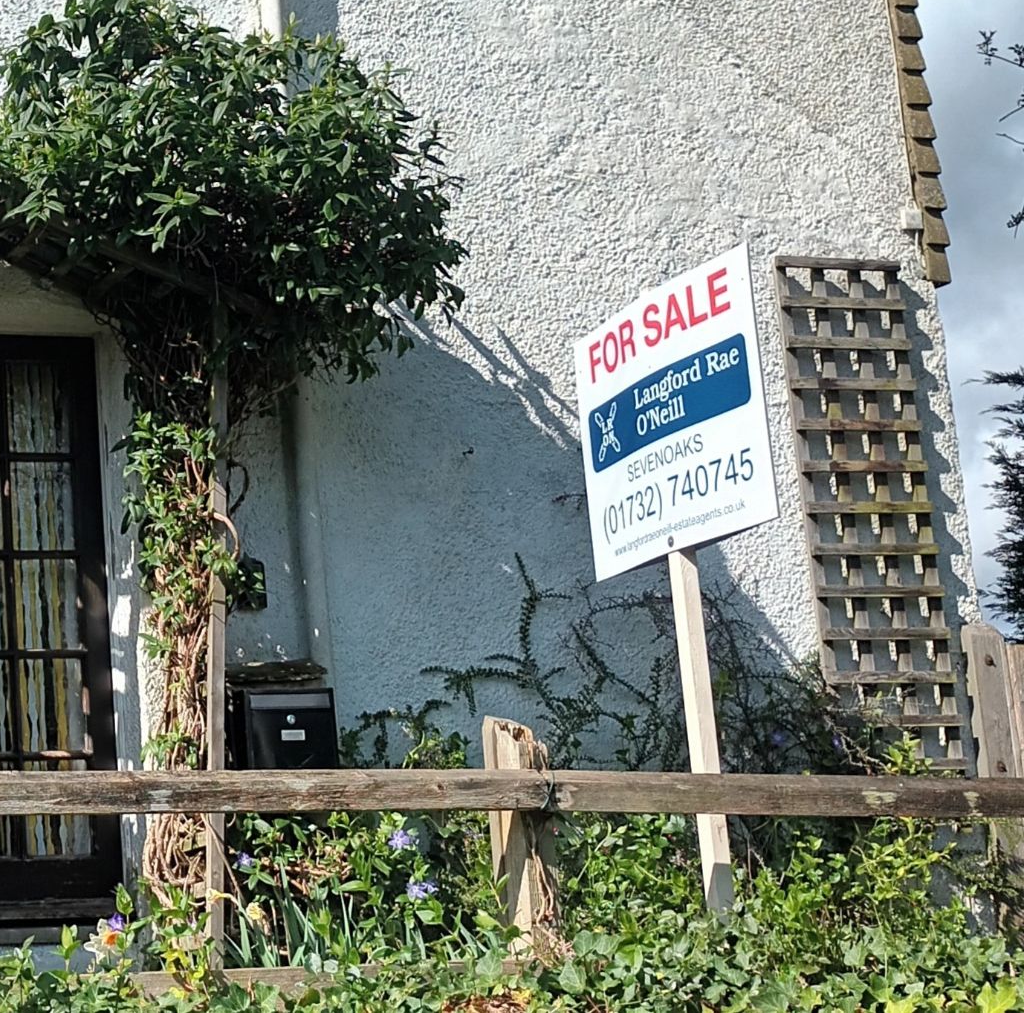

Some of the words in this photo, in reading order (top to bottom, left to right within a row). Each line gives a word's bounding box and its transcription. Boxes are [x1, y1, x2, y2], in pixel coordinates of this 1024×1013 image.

[588, 319, 636, 384] FOR
[643, 267, 731, 347] SALE
[633, 358, 702, 410] Langford
[705, 347, 740, 376] Rae
[636, 394, 685, 435] O'Neill
[627, 433, 704, 483] SEVENOAKS
[603, 482, 663, 545] (01732)
[667, 447, 754, 506] 740745
